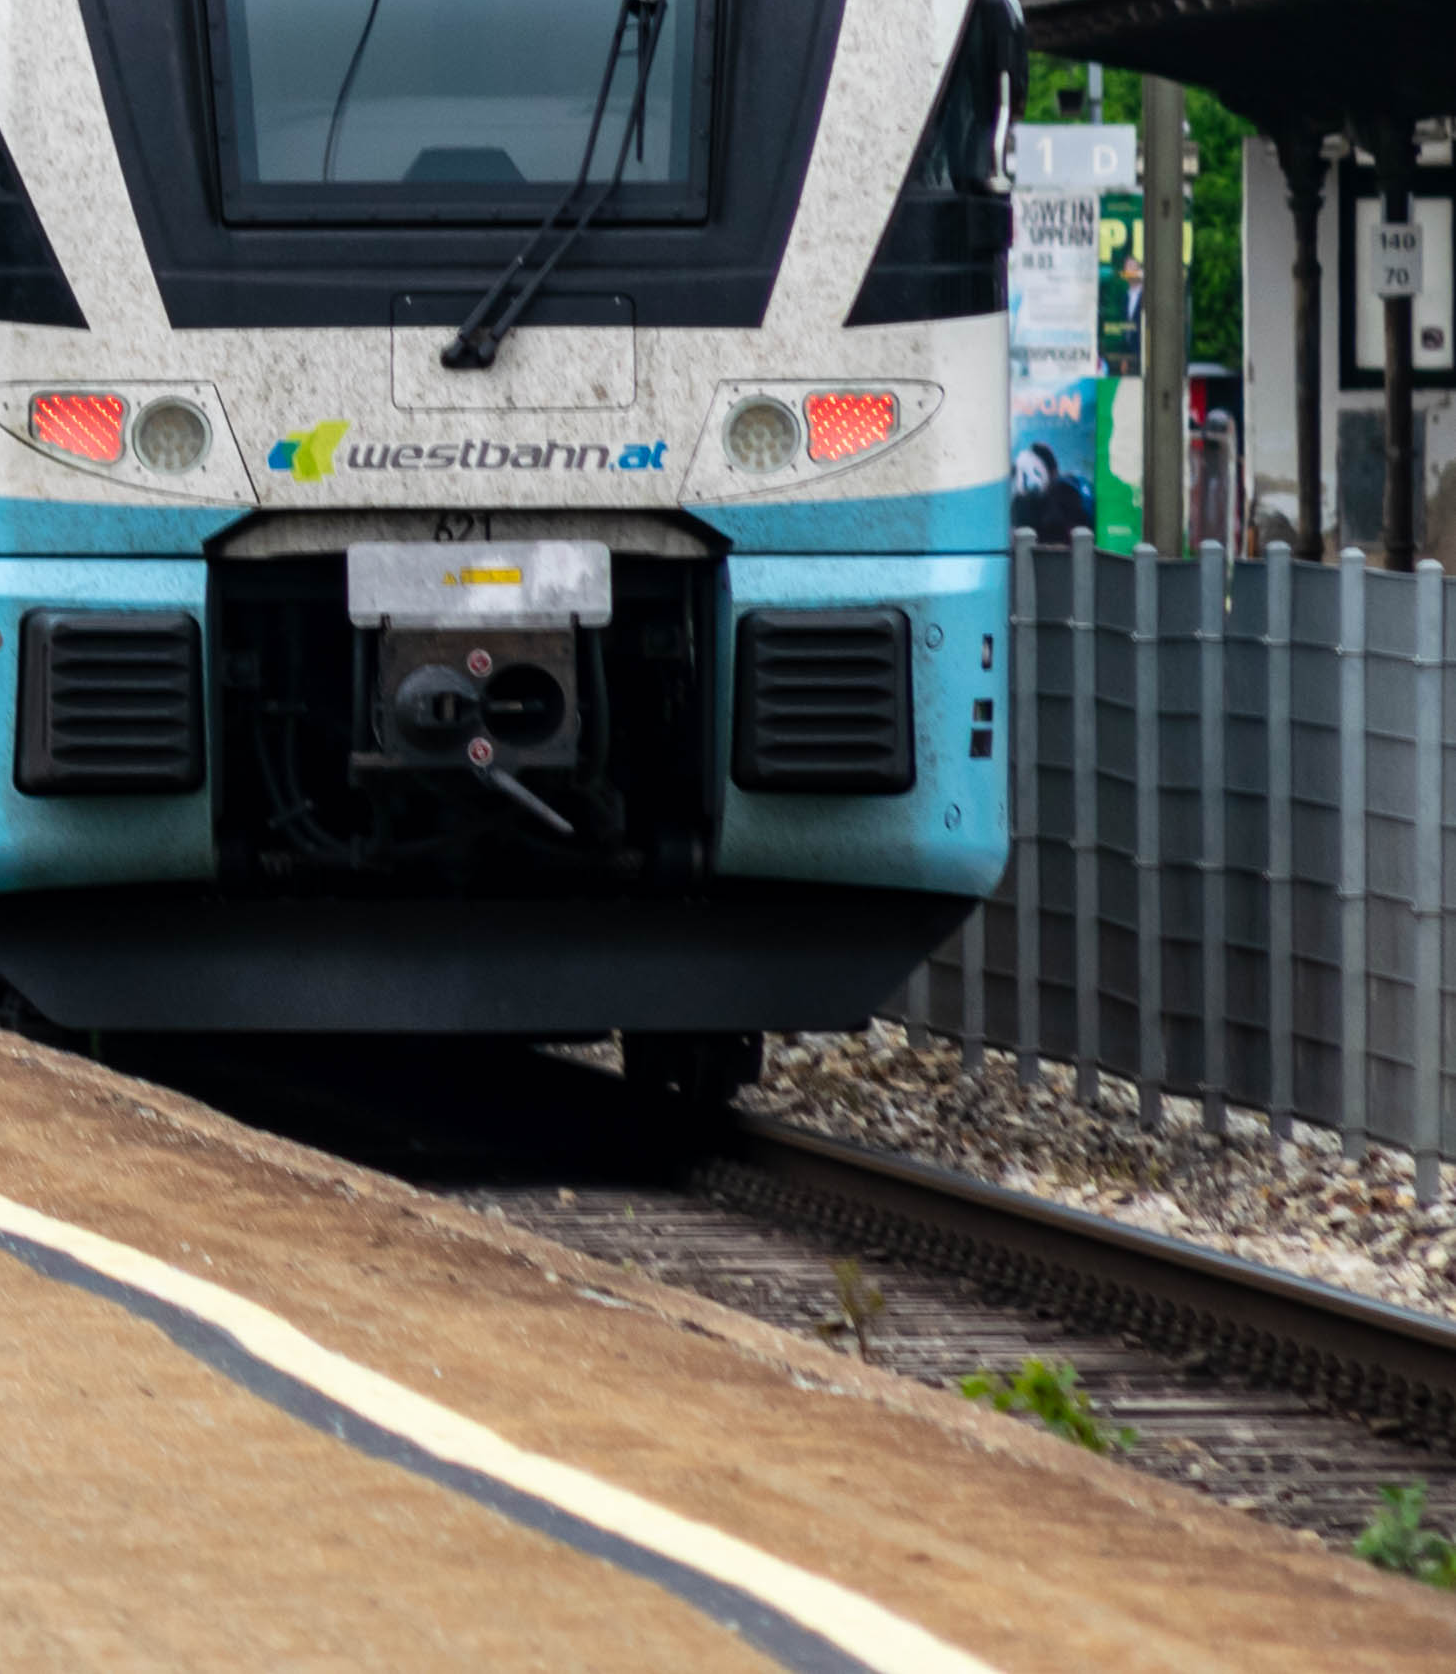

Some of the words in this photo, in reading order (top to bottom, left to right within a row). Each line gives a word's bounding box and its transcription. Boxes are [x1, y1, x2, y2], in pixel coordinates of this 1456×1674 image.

[1035, 137, 1053, 175] 1
[1093, 146, 1118, 175] D
[1381, 232, 1415, 251] 140
[1385, 267, 1410, 286] 70
[348, 439, 668, 471] westbahn.at
